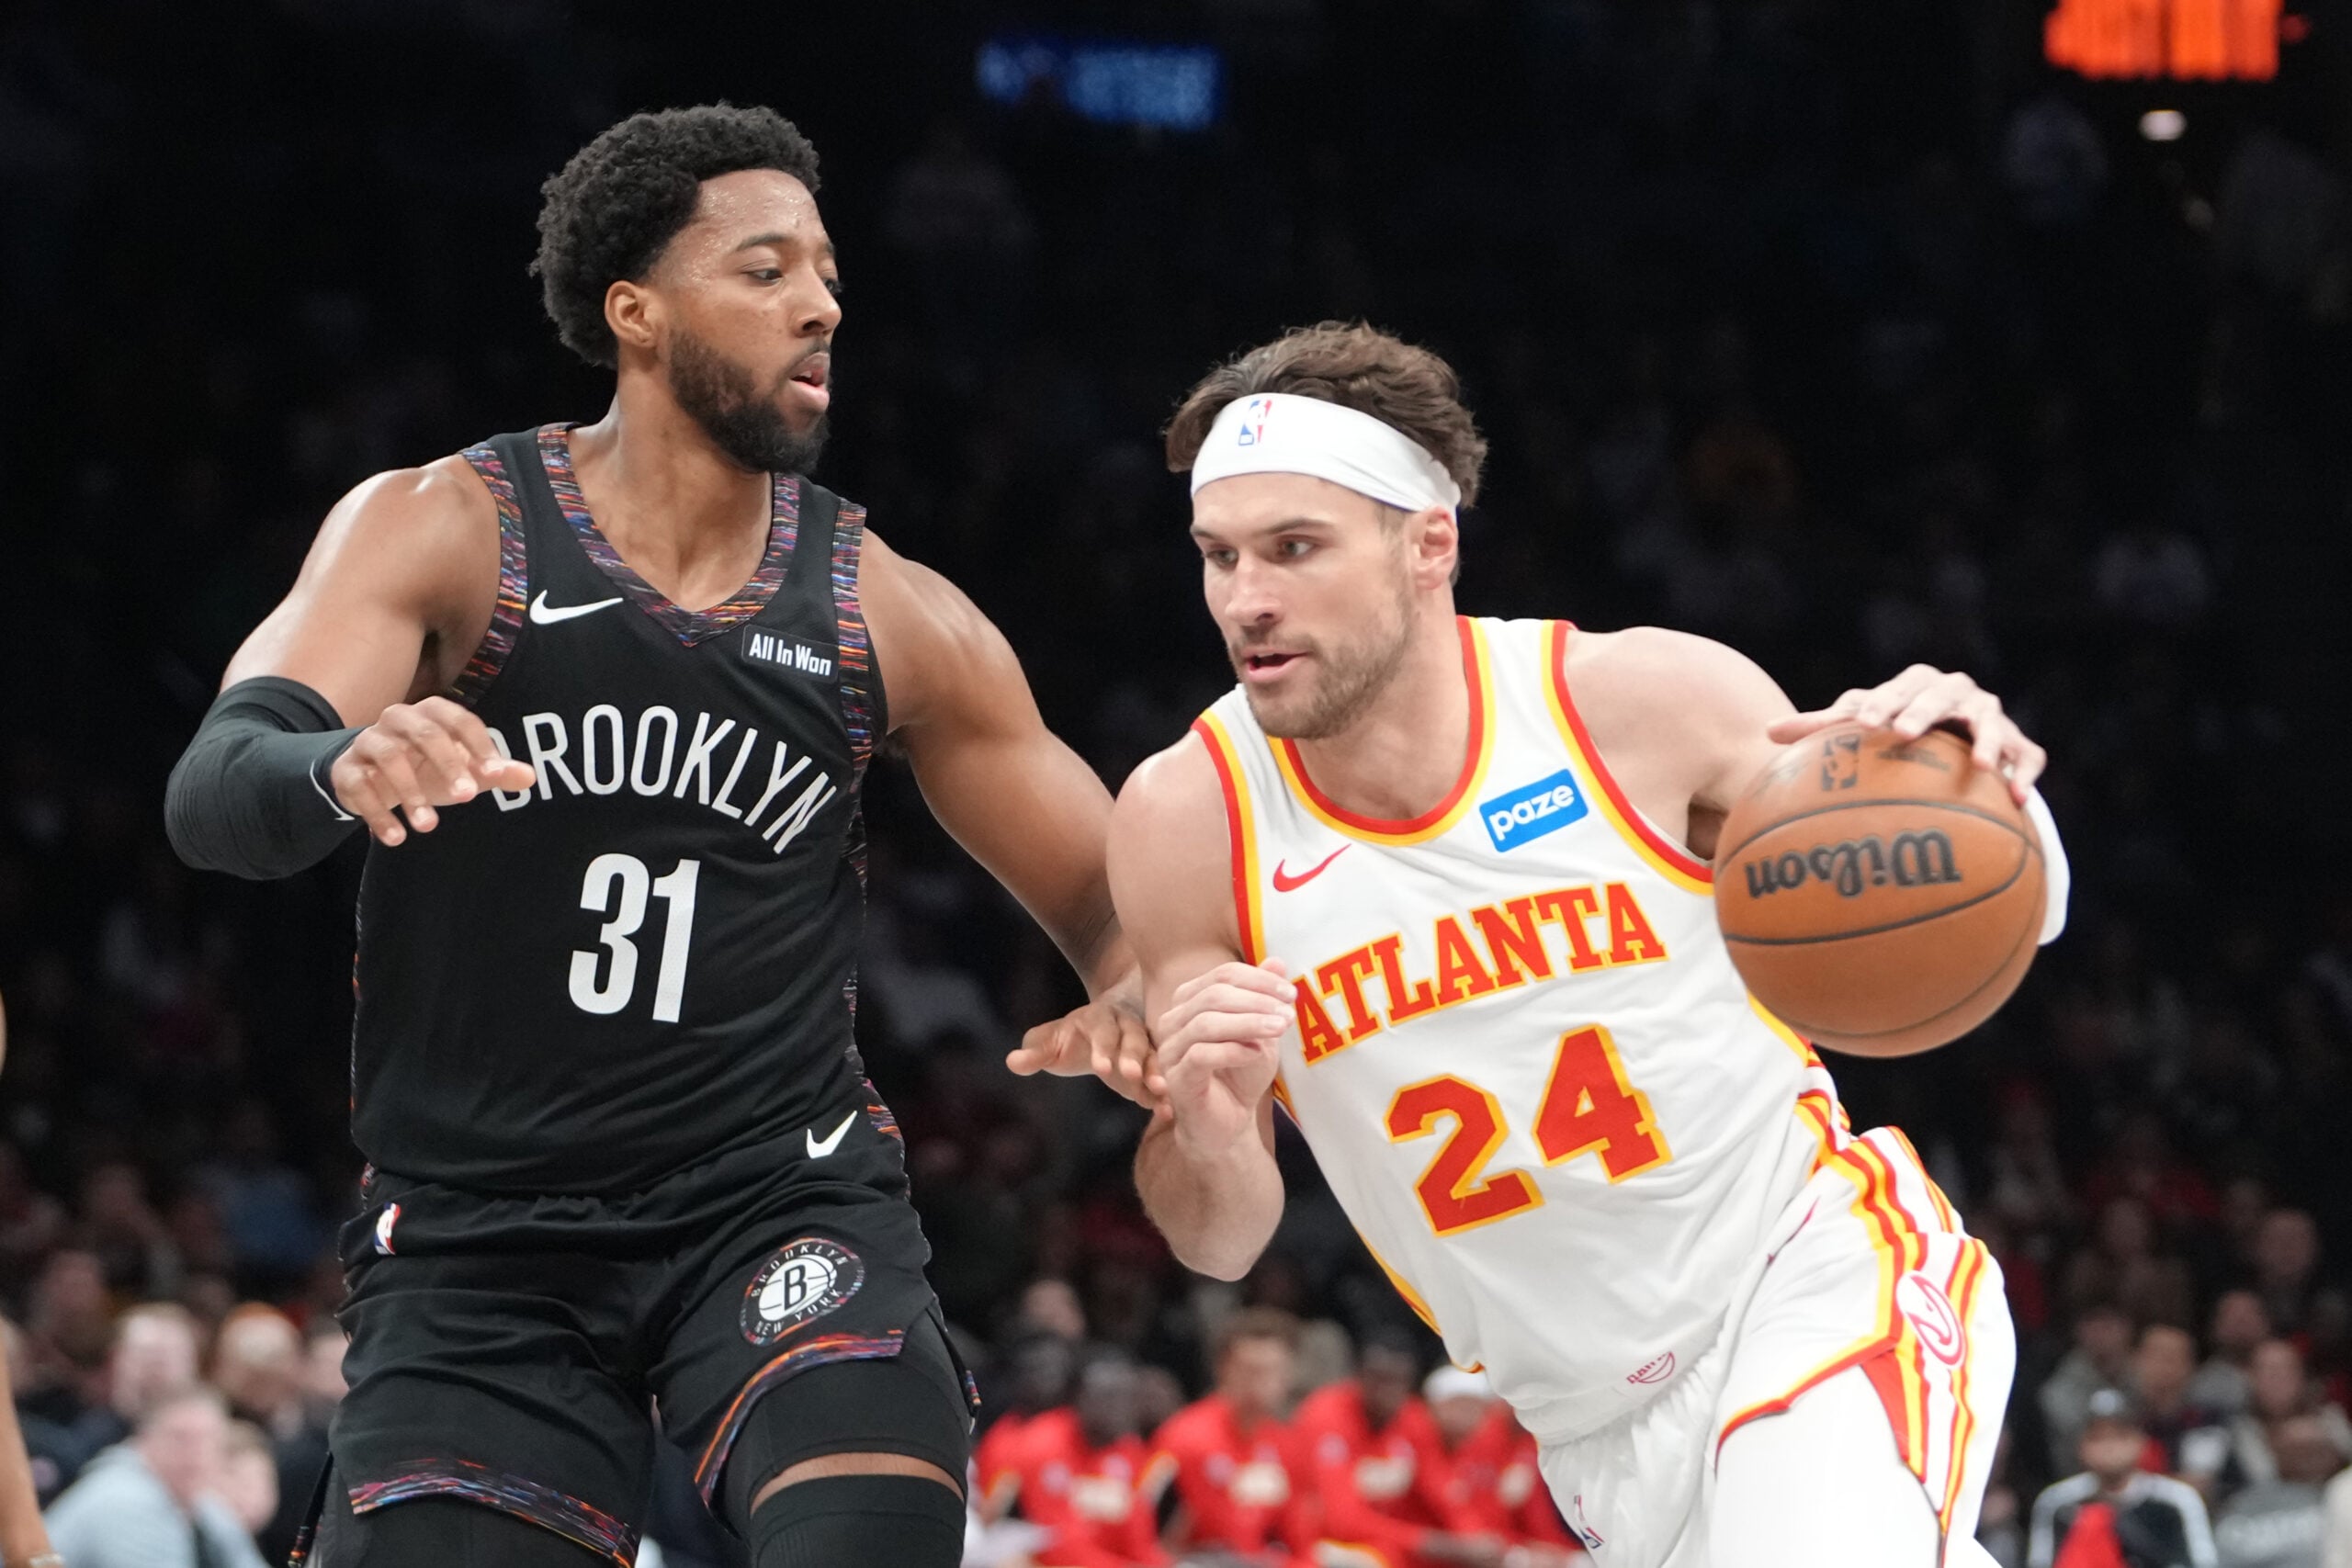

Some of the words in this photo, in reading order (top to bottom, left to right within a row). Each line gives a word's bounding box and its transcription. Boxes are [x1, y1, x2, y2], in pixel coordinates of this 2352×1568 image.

[749, 633, 775, 661] All
[776, 639, 793, 666] In
[796, 644, 831, 676] Won
[1488, 784, 1575, 841] paze
[1745, 828, 1962, 899] Wilson
[568, 853, 701, 1023] 31
[1294, 883, 1668, 1065] ATLANTA
[1385, 1023, 1672, 1235] 24
[784, 1264, 808, 1312] B
